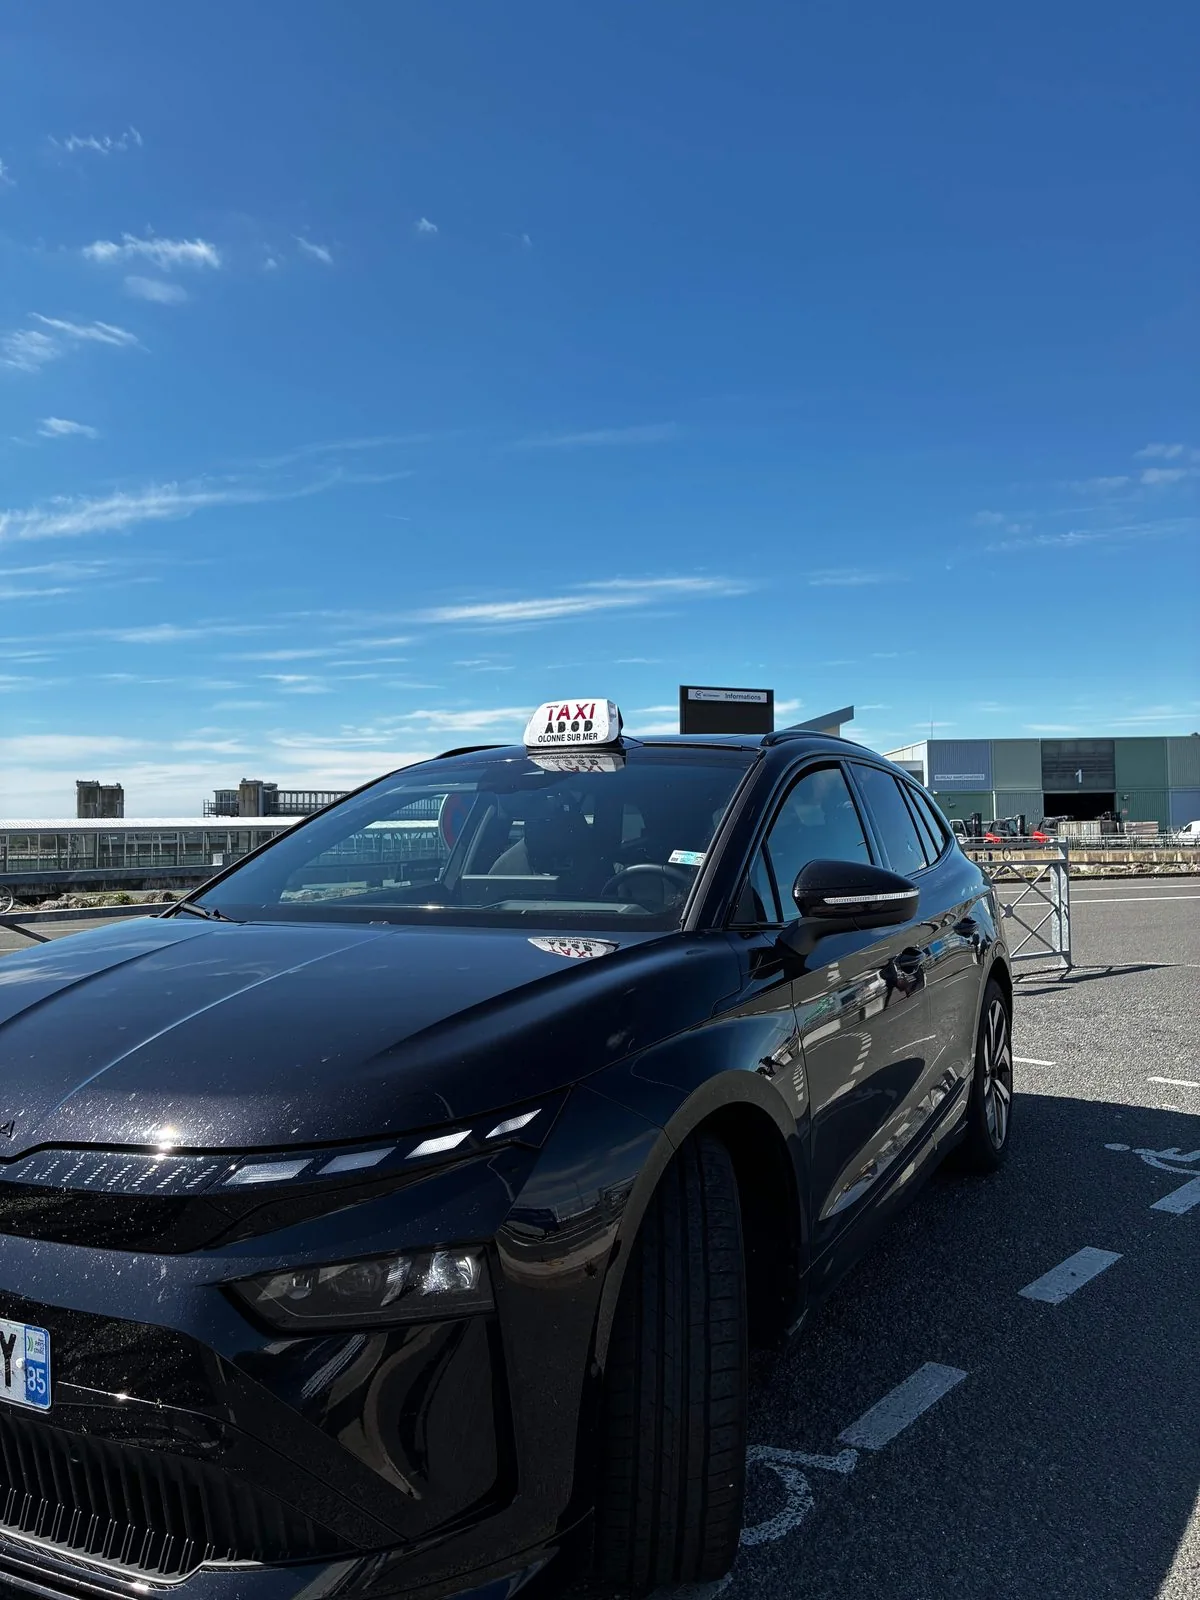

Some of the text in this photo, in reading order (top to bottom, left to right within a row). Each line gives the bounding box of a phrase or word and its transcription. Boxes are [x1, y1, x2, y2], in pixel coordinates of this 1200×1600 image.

[546, 703, 596, 721] TAXI
[537, 732, 598, 743] OLONNE SUR MER
[1075, 769, 1082, 783] 1
[0, 1330, 17, 1387] Y
[27, 1366, 46, 1394] 85
